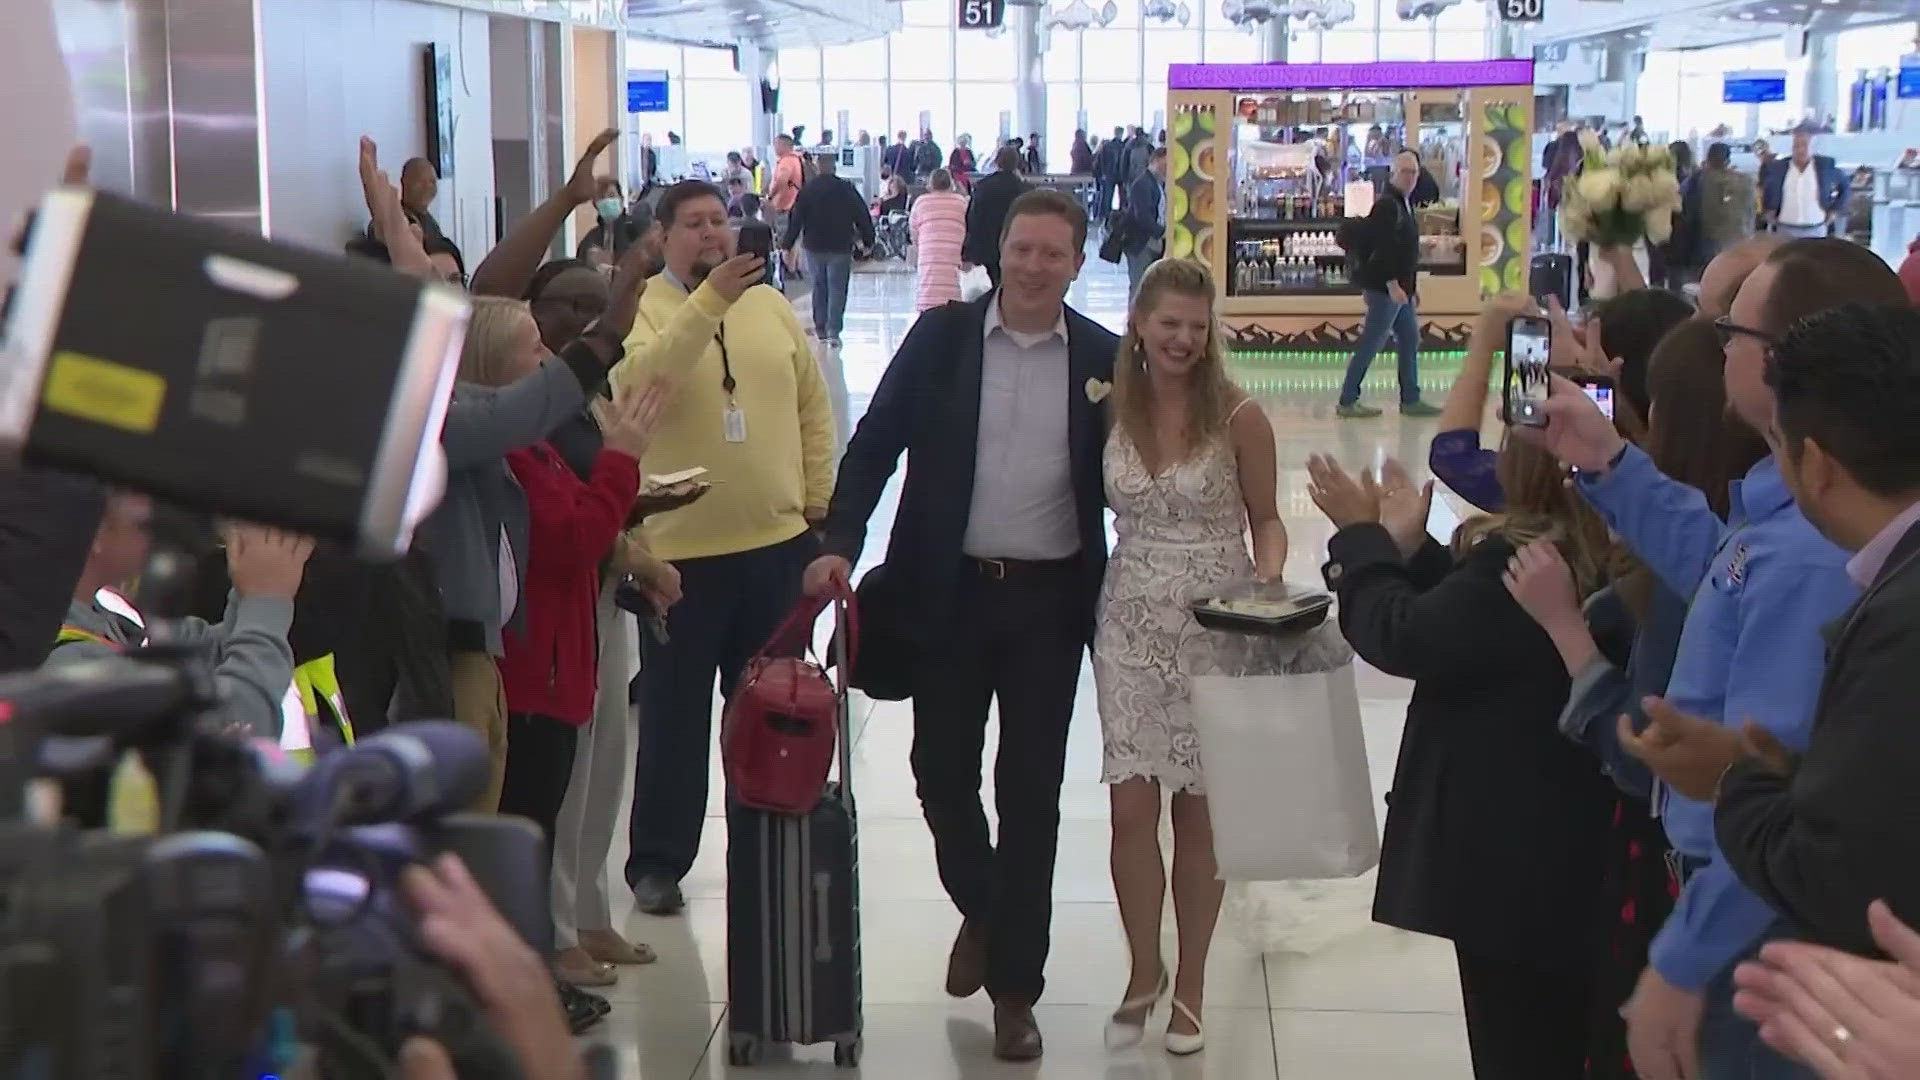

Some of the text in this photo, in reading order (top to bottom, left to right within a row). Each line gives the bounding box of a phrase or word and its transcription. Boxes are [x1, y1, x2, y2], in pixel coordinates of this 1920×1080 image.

[965, 0, 992, 24] 51
[1507, 0, 1540, 17] 50
[1183, 63, 1519, 84] ROCKY MOUNTAIN CHOCOLATE FACTOR
